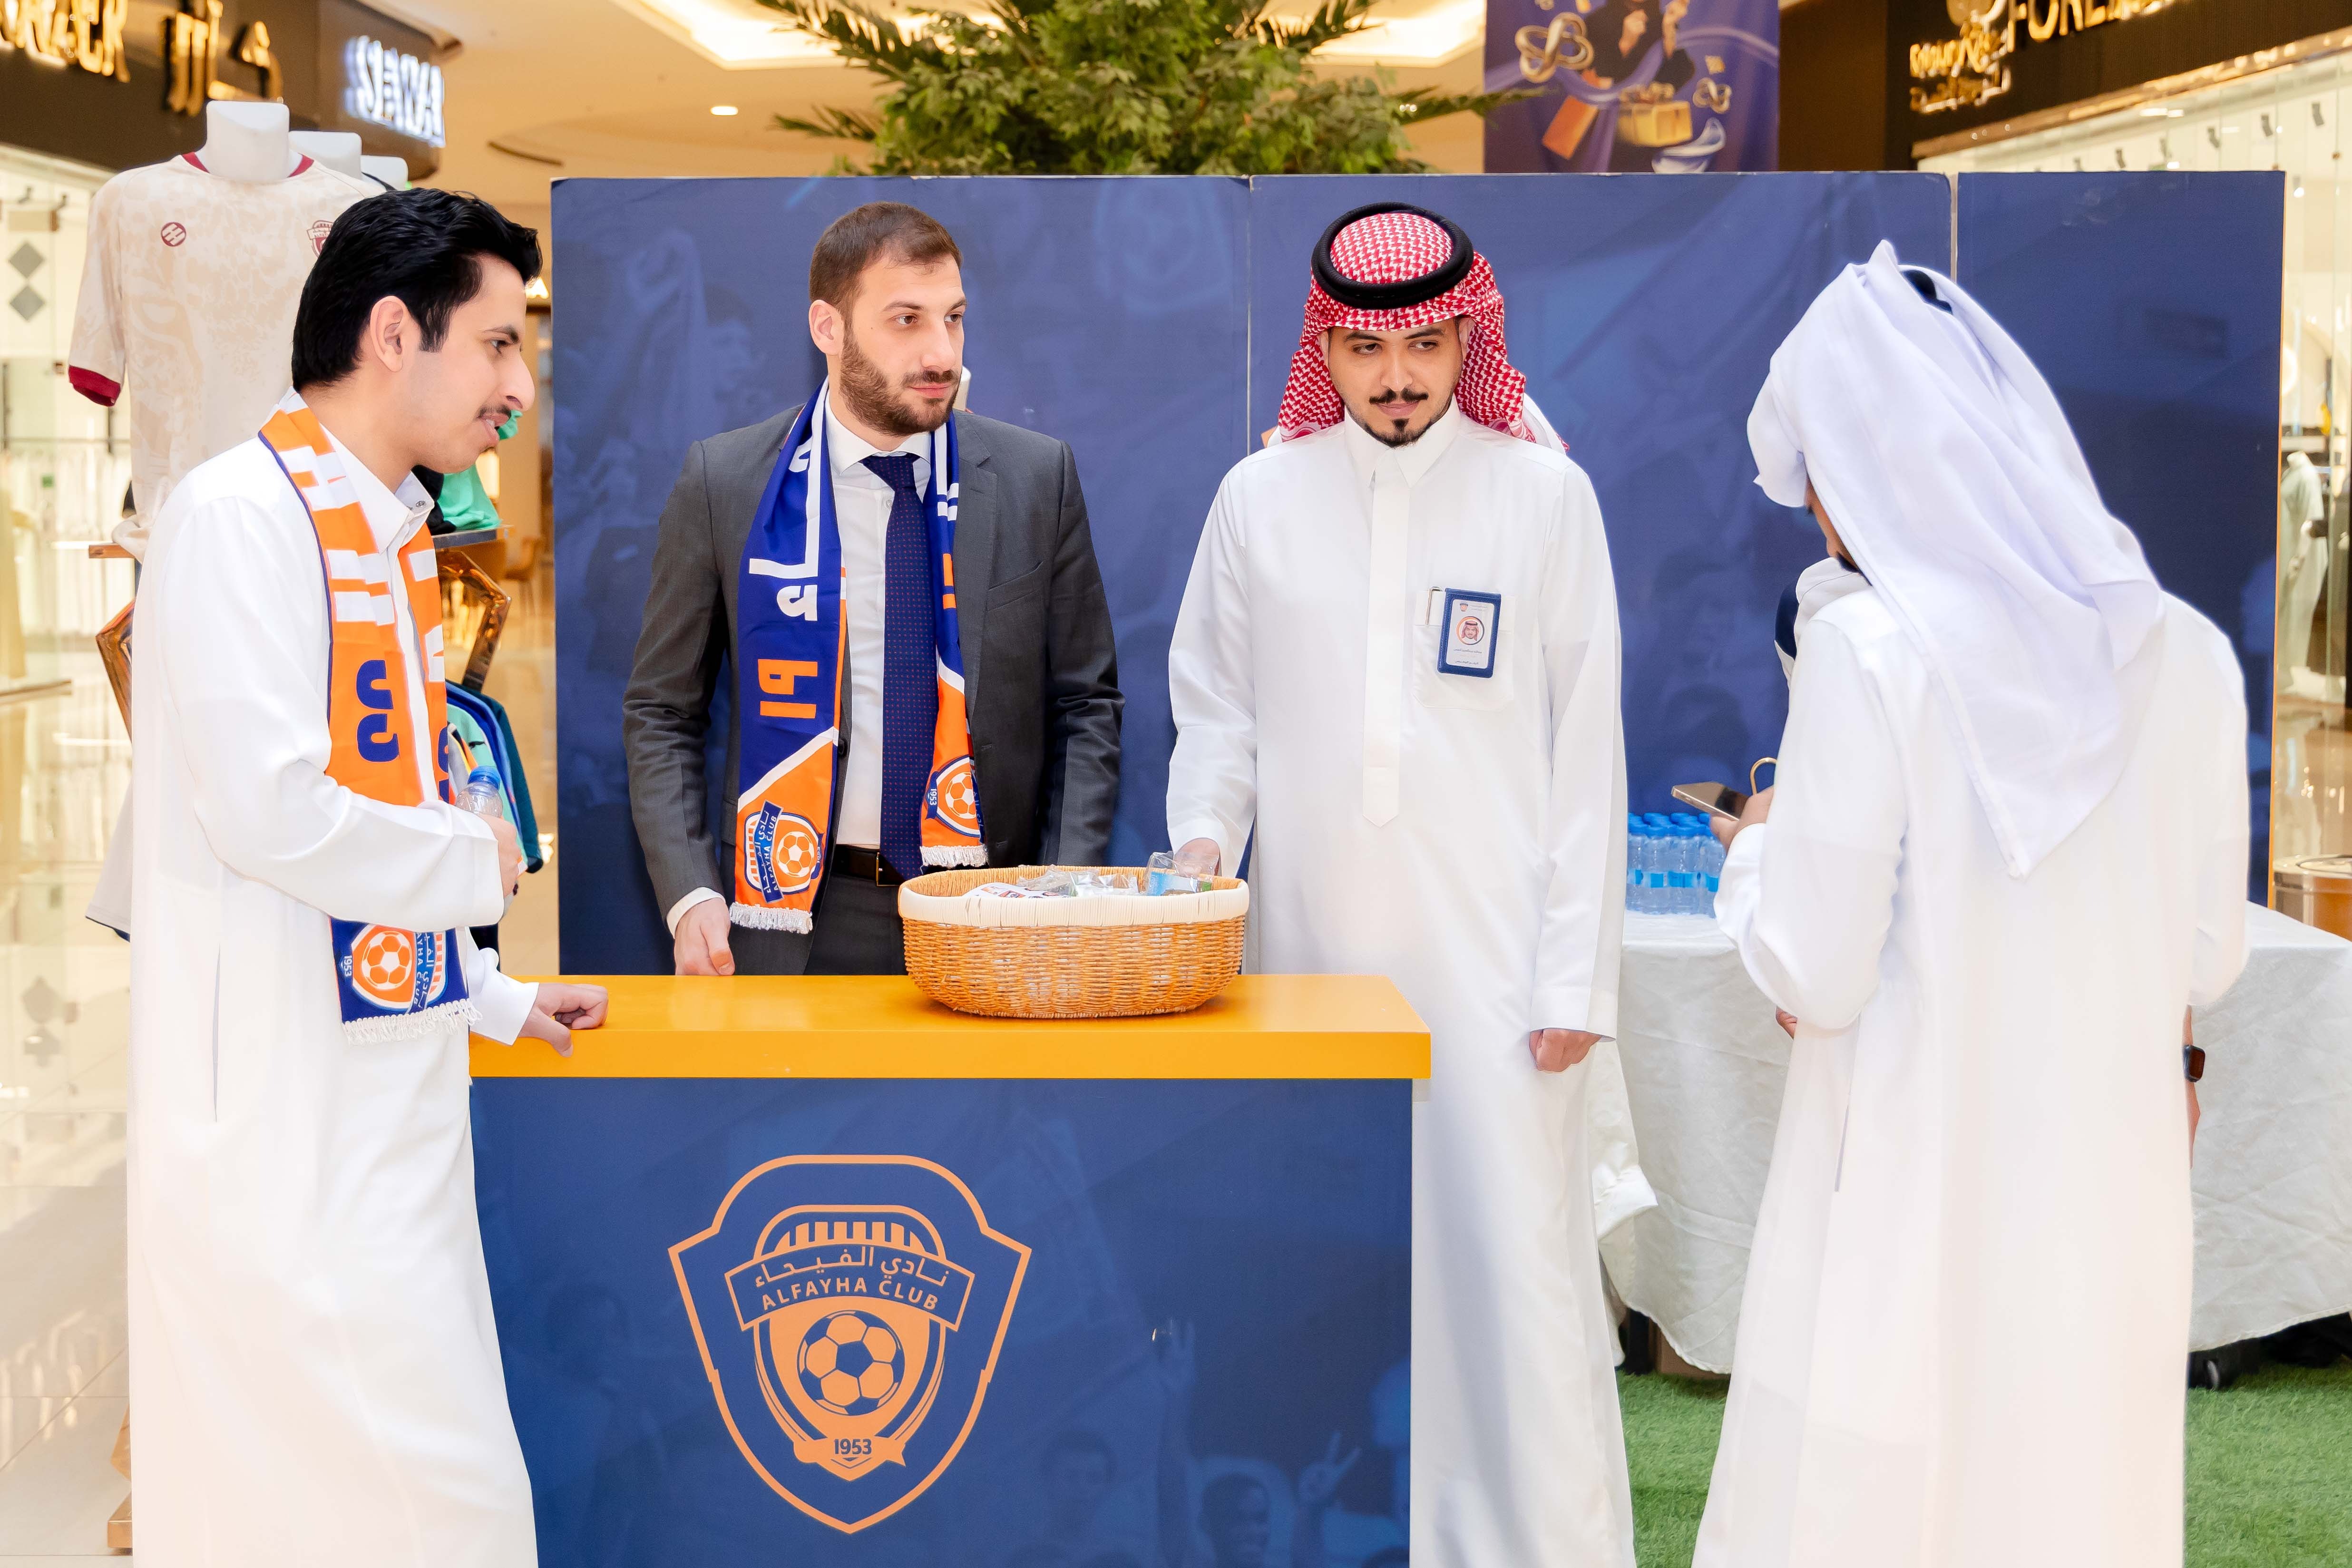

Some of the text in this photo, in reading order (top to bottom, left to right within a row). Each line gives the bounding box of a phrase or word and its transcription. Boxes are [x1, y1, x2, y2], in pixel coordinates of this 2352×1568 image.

[763, 815, 779, 891] ALFAYHA CLUB
[344, 955, 352, 976] 1953
[413, 971, 422, 1005] CLUB
[755, 1246, 950, 1288] نادي الفيحاء
[761, 1277, 938, 1311] ALFAYHA CLUB
[833, 1438, 872, 1455] 1953
